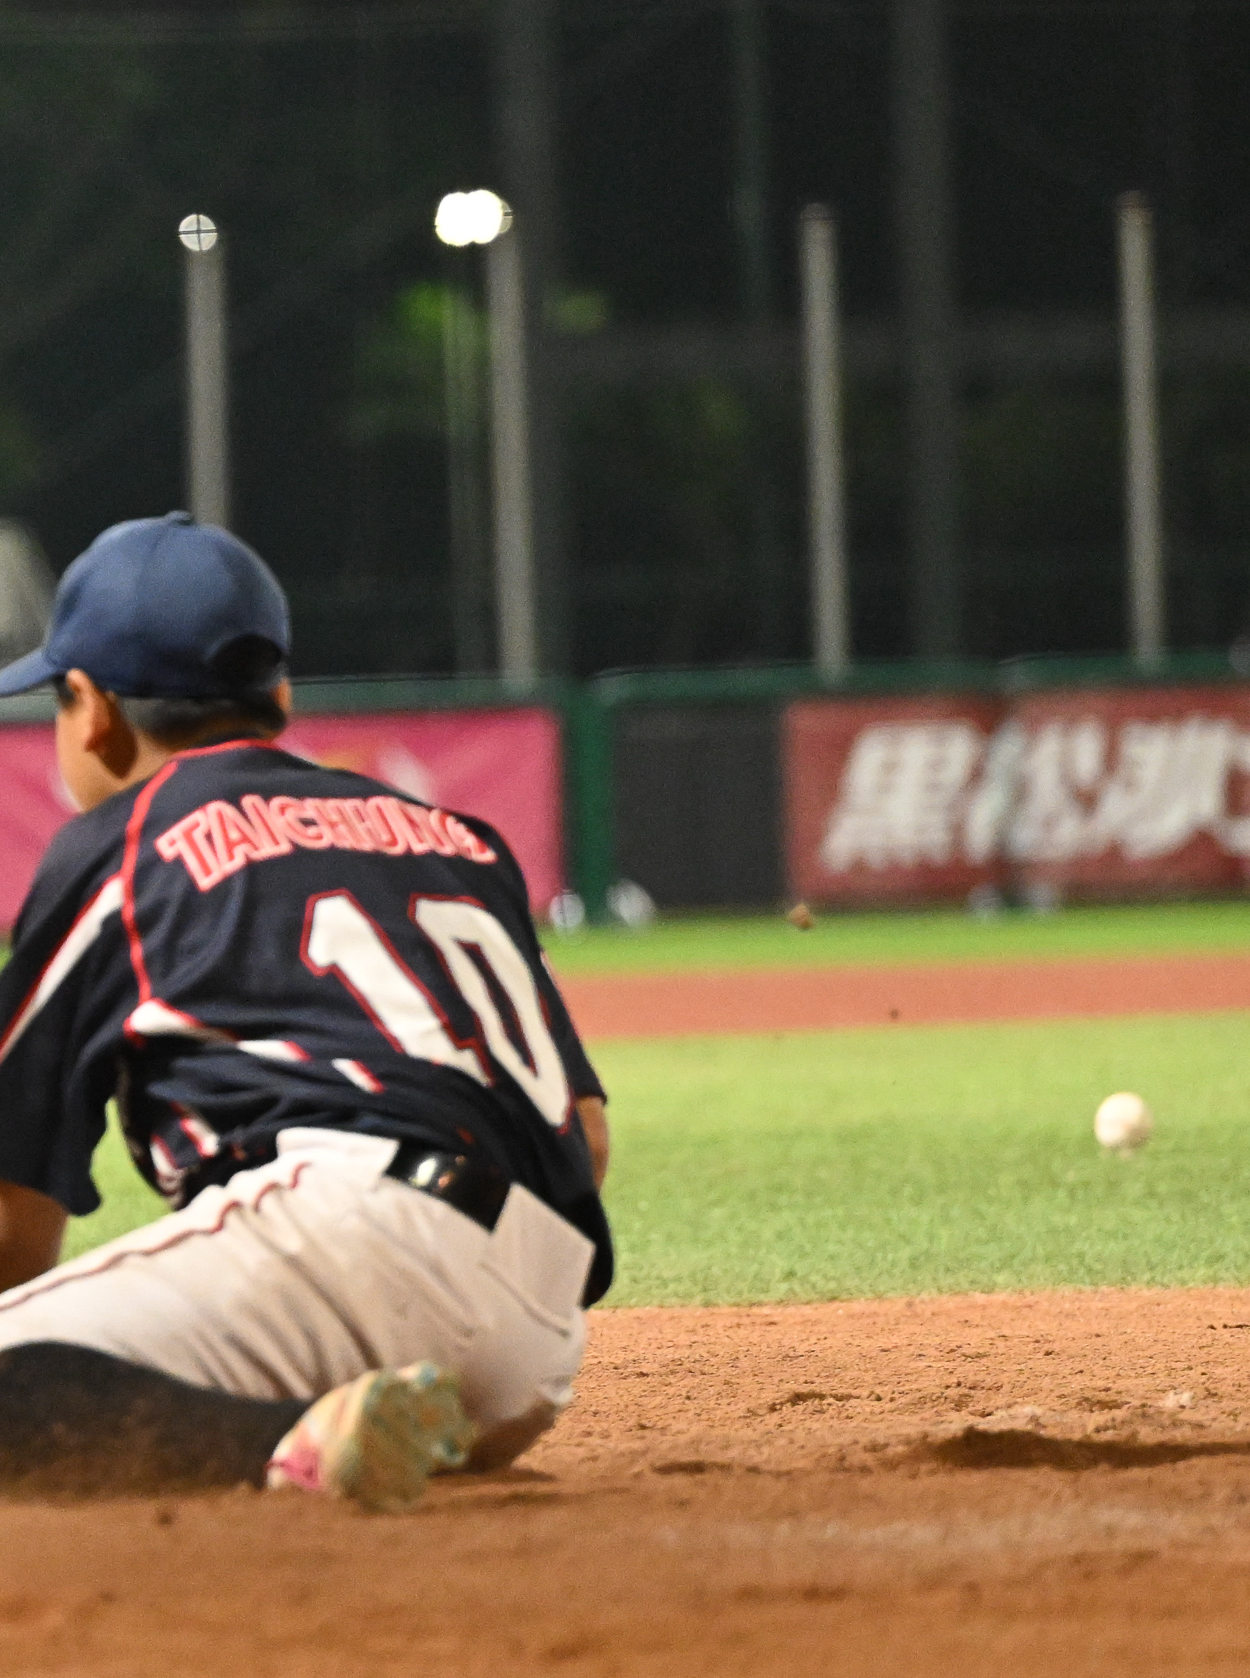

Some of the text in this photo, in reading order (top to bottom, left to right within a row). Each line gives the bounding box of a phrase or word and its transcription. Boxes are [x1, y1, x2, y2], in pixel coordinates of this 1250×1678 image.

[155, 794, 497, 892] TAICHUNG
[819, 716, 1250, 873] 黑松沙
[299, 887, 576, 1136] 10
